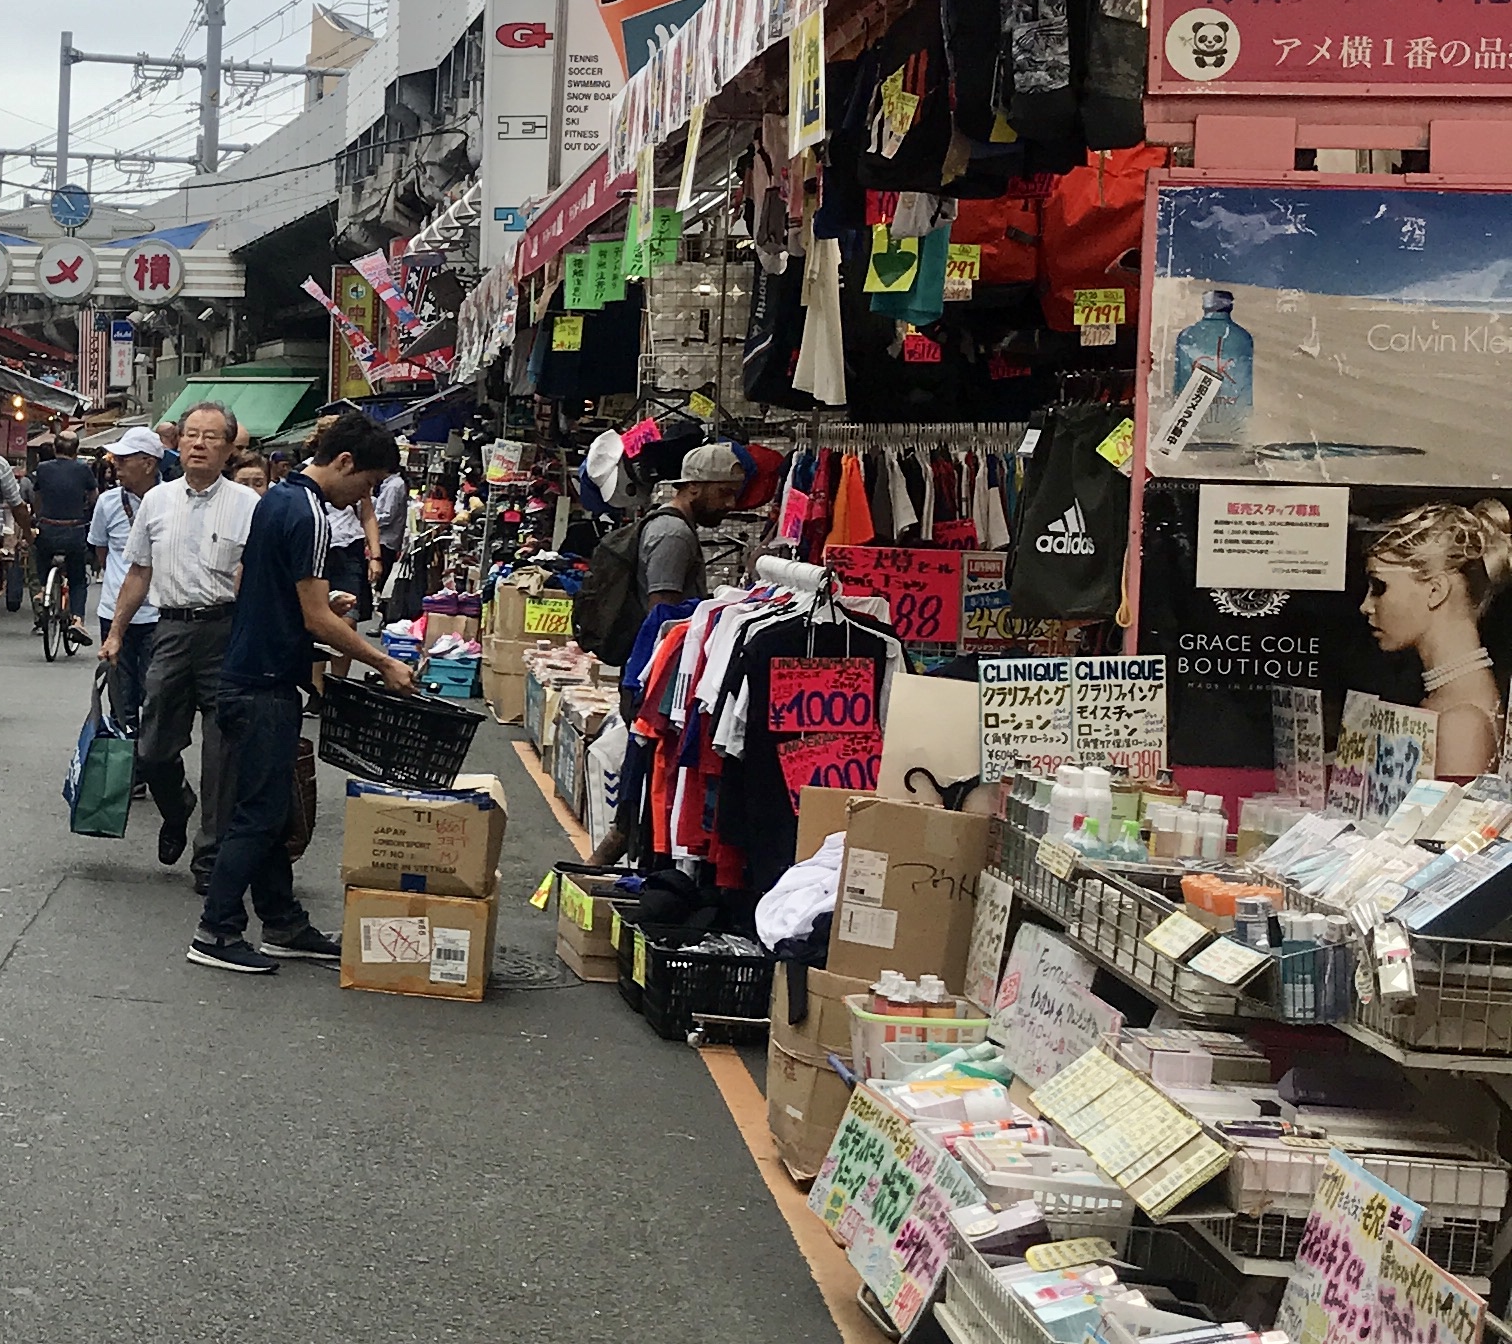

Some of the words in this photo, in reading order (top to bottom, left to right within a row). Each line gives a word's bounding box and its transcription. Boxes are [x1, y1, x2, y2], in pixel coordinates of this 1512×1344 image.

[569, 54, 599, 63] TENNIS
[1271, 34, 1512, 70] アメ横1番の品
[568, 67, 604, 76] SOCCER
[567, 80, 611, 88] SWIMMING
[566, 92, 592, 101] SNOW
[566, 105, 589, 113] GOLF
[565, 117, 580, 126] SKI
[564, 130, 599, 139] FITNESS
[1366, 324, 1456, 353] Calvin
[1035, 532, 1095, 555] adidas
[1178, 632, 1252, 653] GRACE
[1260, 636, 1320, 654] COLE
[983, 661, 1069, 683] CLINIQUE
[1074, 659, 1165, 681] CLINIQUE
[1177, 656, 1320, 679] BOUTIQUE
[982, 684, 1071, 707] クラリファイング
[1077, 682, 1164, 703] クラリファイング
[770, 689, 872, 730] ¥1000
[1076, 705, 1147, 722] モイスチャー
[984, 712, 1052, 731] ローション
[1077, 724, 1138, 737] ローション
